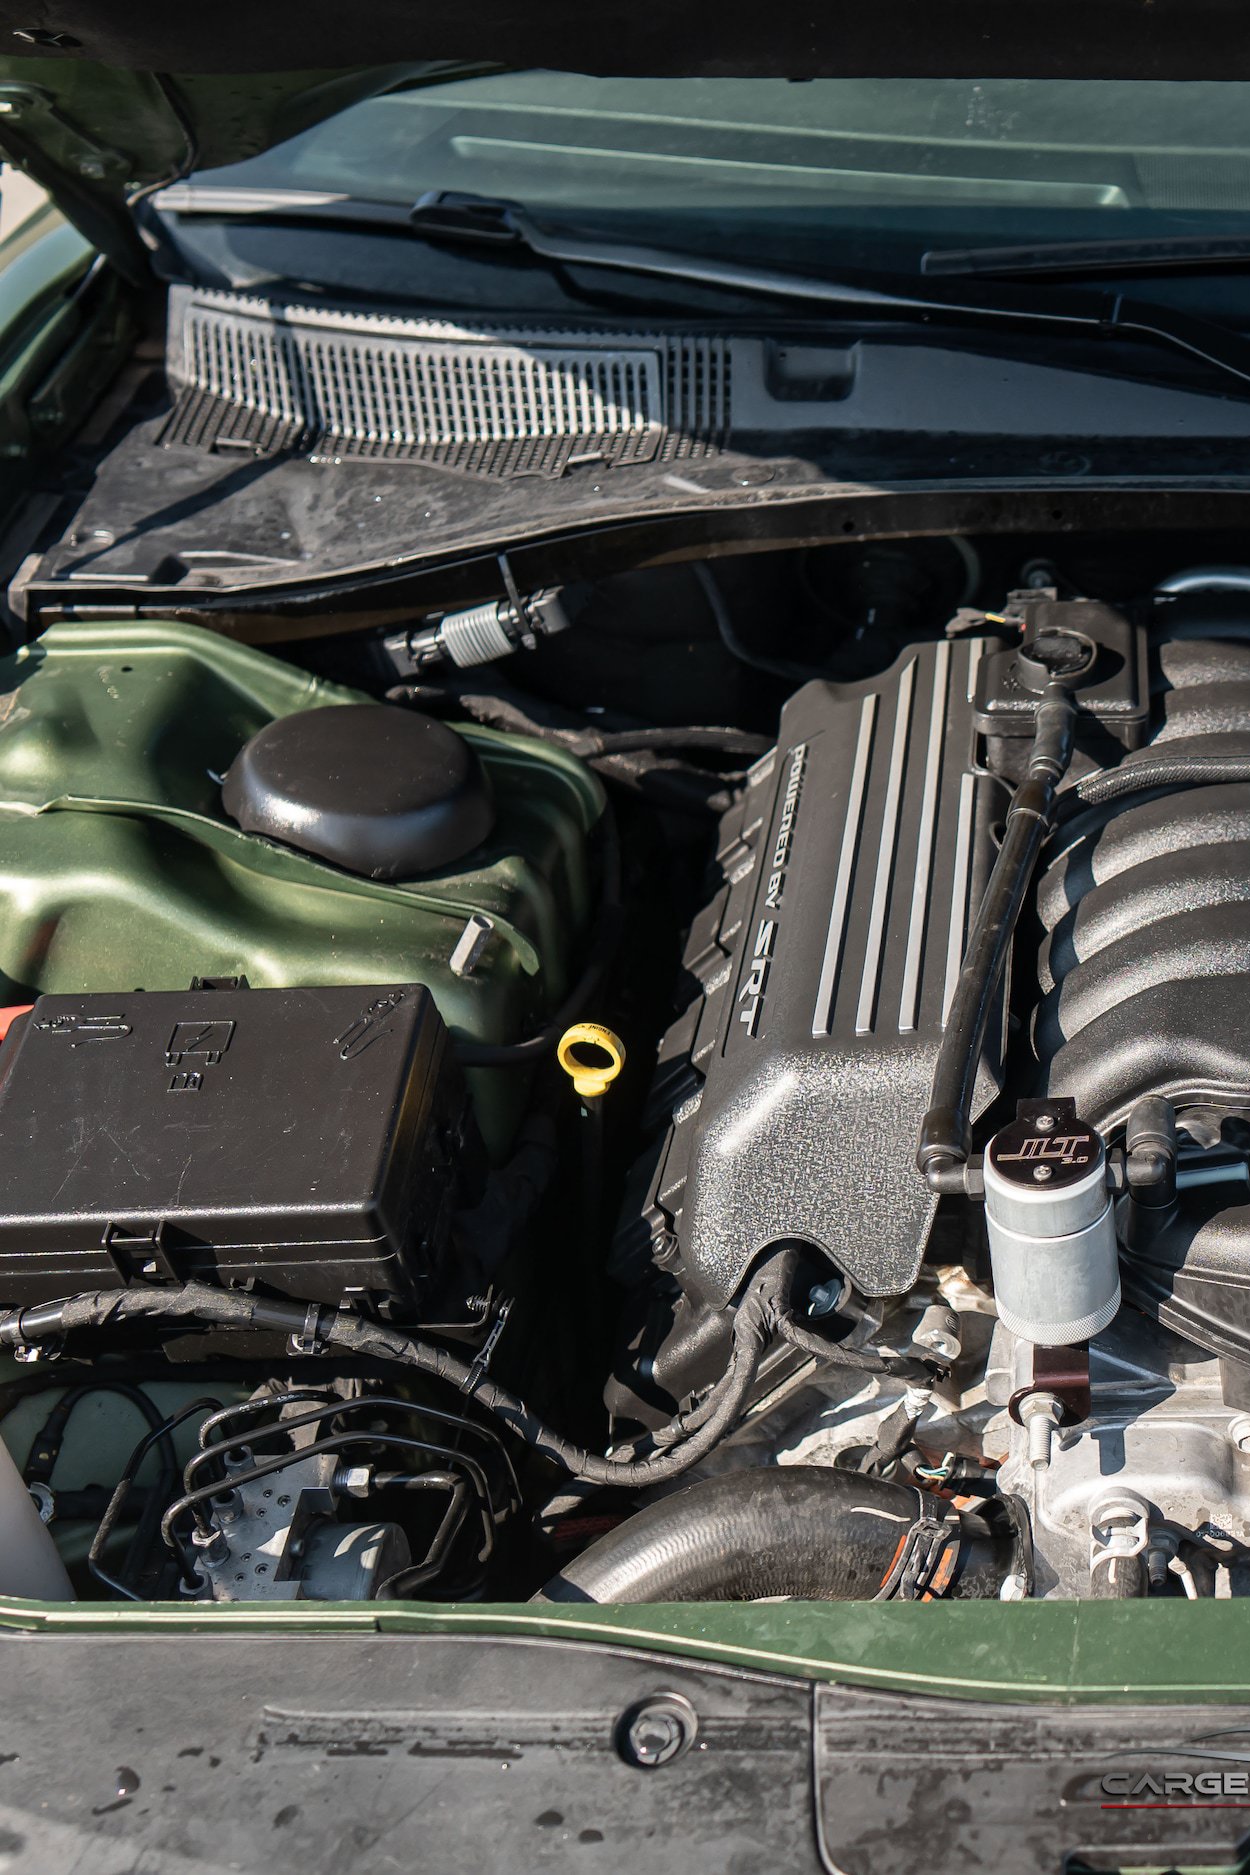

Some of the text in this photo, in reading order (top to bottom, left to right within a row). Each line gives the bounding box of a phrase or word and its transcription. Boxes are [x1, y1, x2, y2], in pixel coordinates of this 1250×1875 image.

[739, 743, 808, 1038] POWERED BY SRT
[997, 1135, 1090, 1161] JLT
[1061, 1156, 1089, 1164] 3.0
